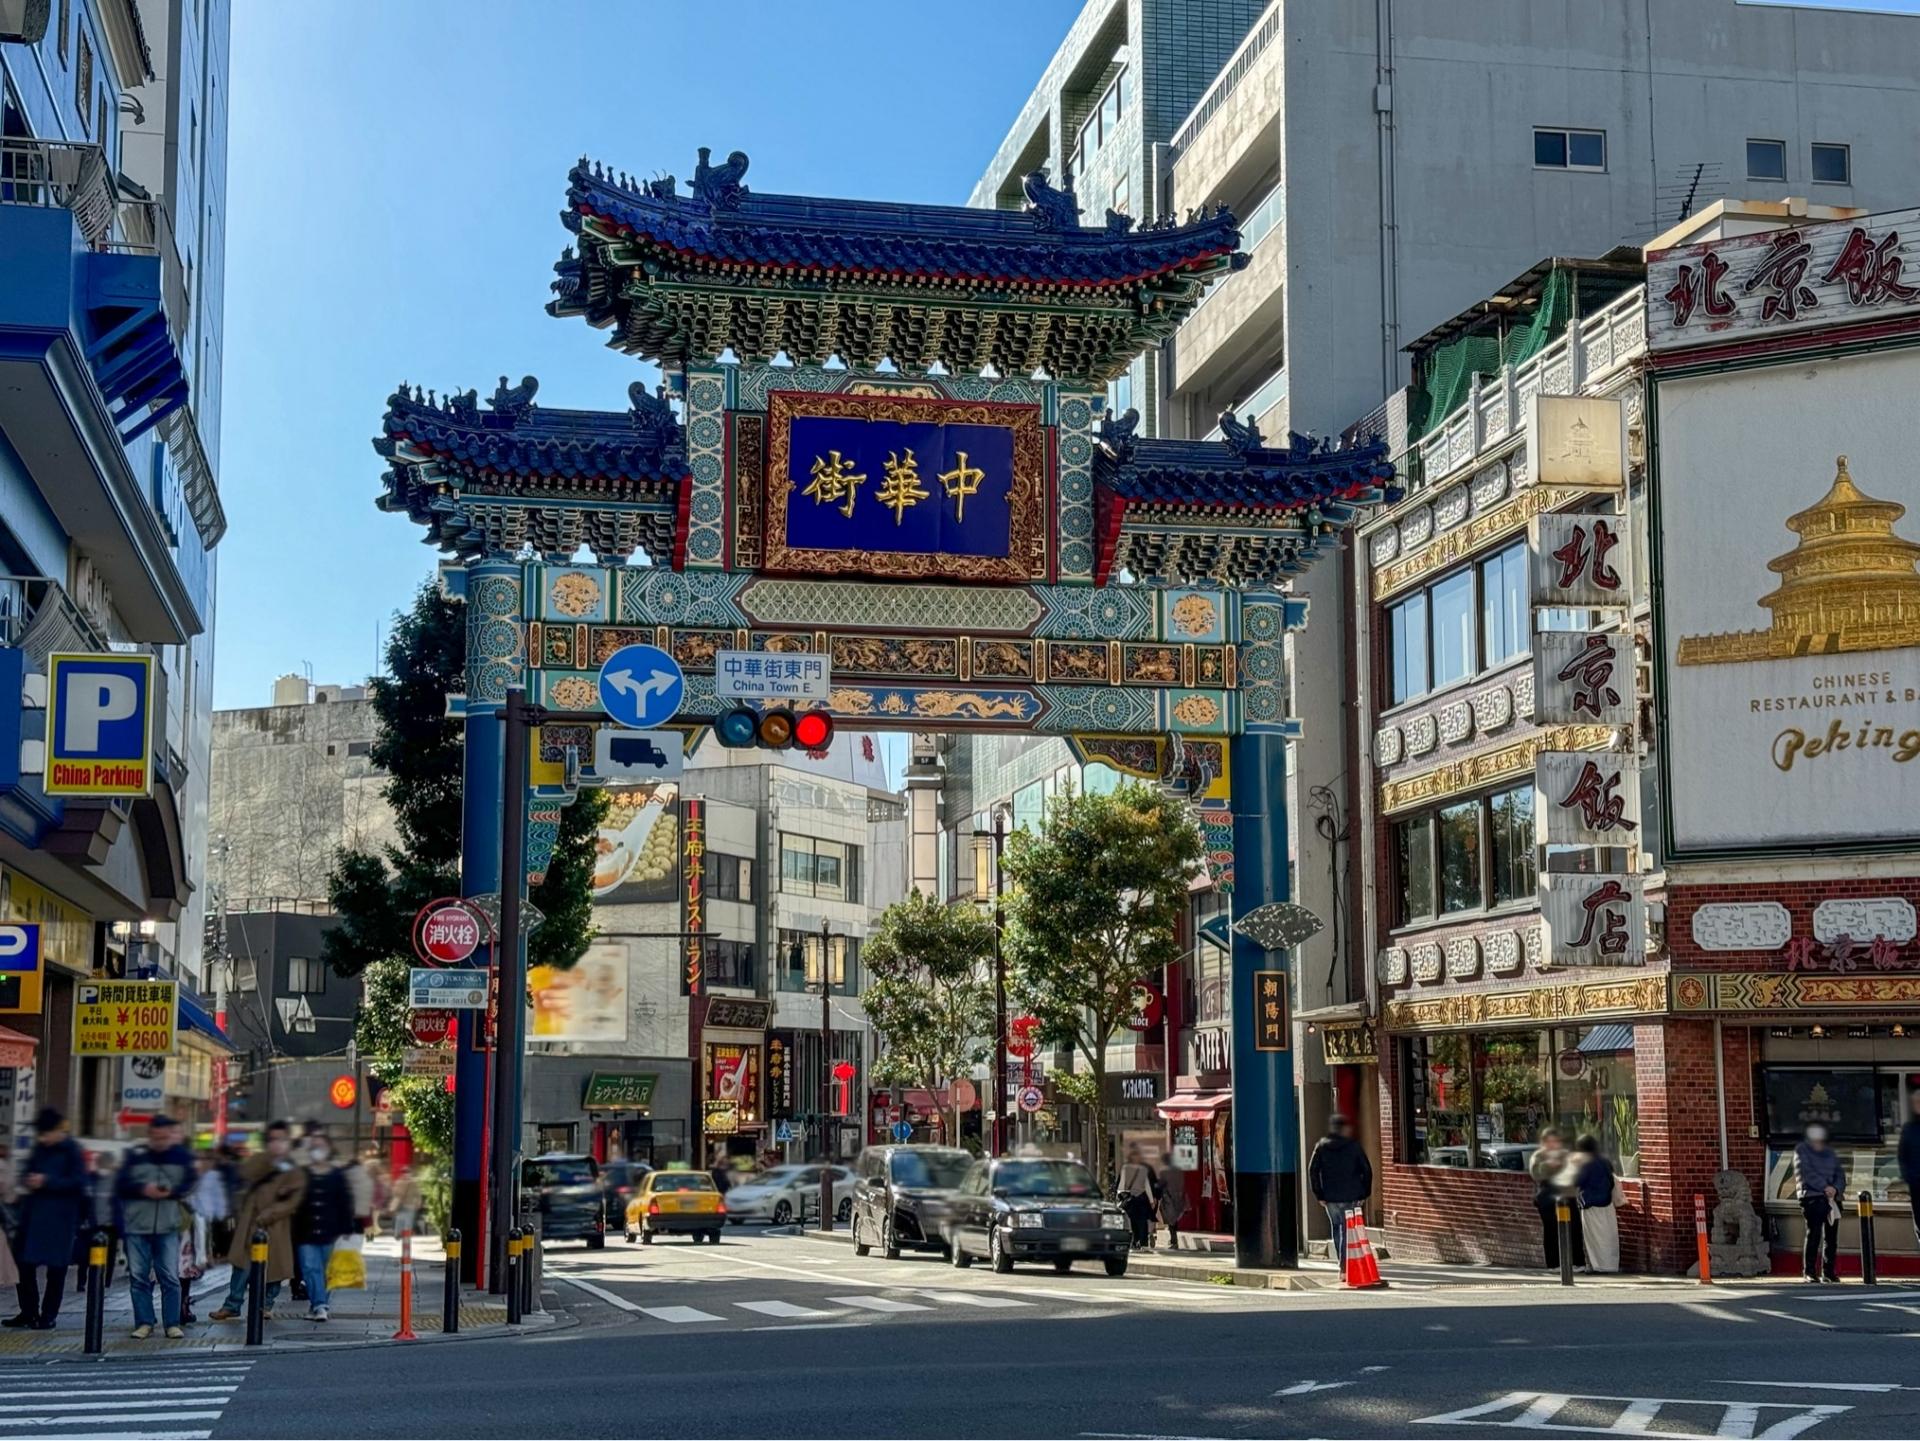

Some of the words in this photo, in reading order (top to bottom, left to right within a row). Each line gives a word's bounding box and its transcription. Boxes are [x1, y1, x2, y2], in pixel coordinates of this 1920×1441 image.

[724, 657, 822, 680] 中華街東門
[1812, 671, 1892, 689] CHINESE
[733, 680, 765, 693] China
[770, 680, 799, 693] Town
[64, 673, 138, 752] P
[1750, 691, 1879, 713] RESTAURANT
[1886, 689, 1897, 704] &
[1904, 688, 1920, 702] B
[1771, 718, 1920, 772] Peking
[53, 764, 91, 786] China
[94, 765, 144, 789] Parking
[683, 818, 705, 985] 王府井レストラン
[428, 924, 474, 945] 消火栓
[101, 986, 172, 1003] 時間貸駐車場
[1264, 978, 1280, 1041] 朝陽門
[415, 1018, 446, 1032] 消火栓
